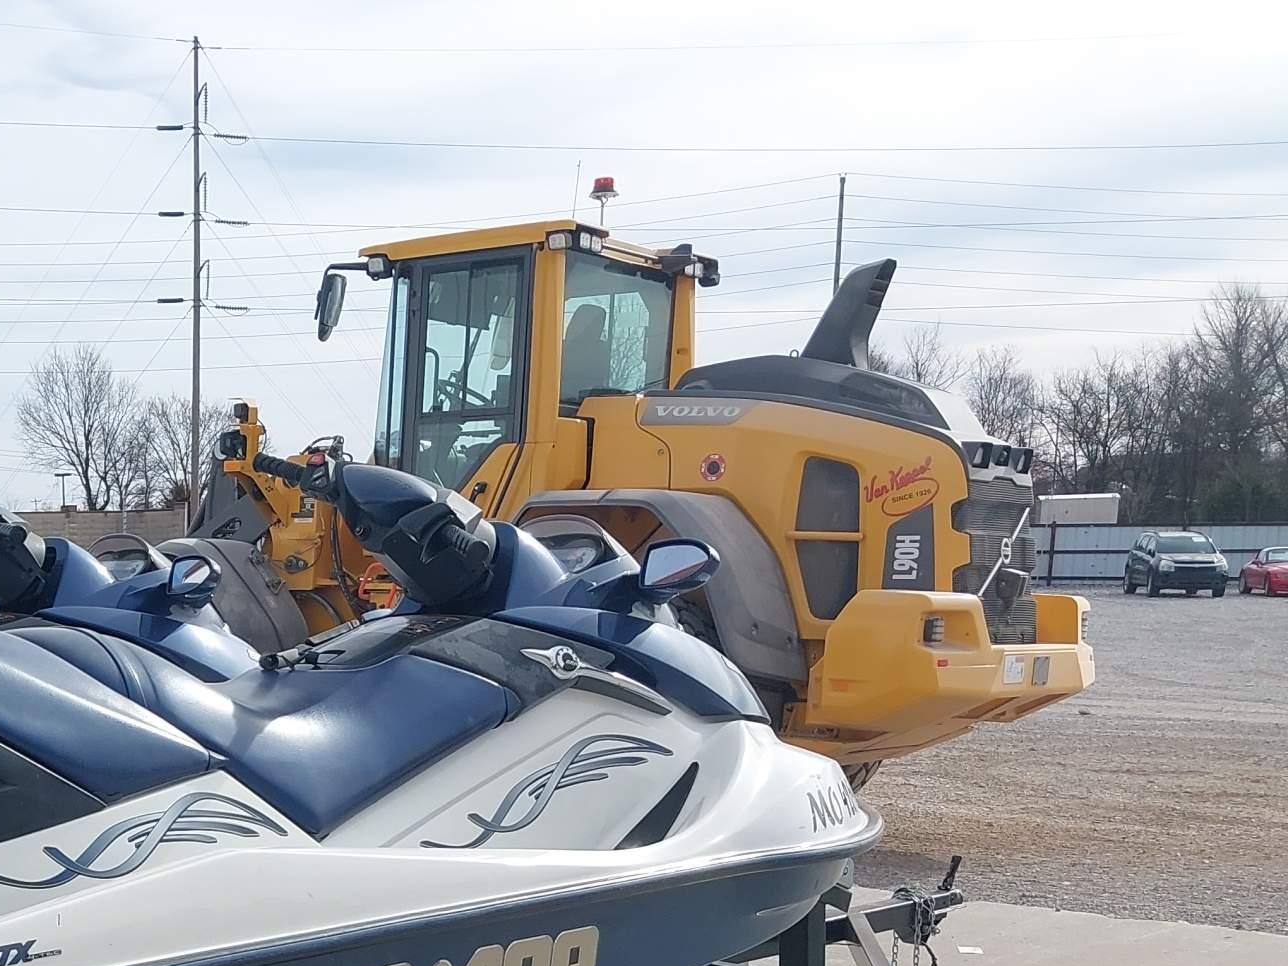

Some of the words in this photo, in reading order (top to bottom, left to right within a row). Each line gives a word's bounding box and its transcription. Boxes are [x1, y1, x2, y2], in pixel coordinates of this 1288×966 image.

[655, 405, 741, 417] VOLVO
[863, 475, 890, 503] Van
[891, 492, 914, 504] SINCE
[892, 535, 921, 580] L90H
[806, 785, 844, 833] MO
